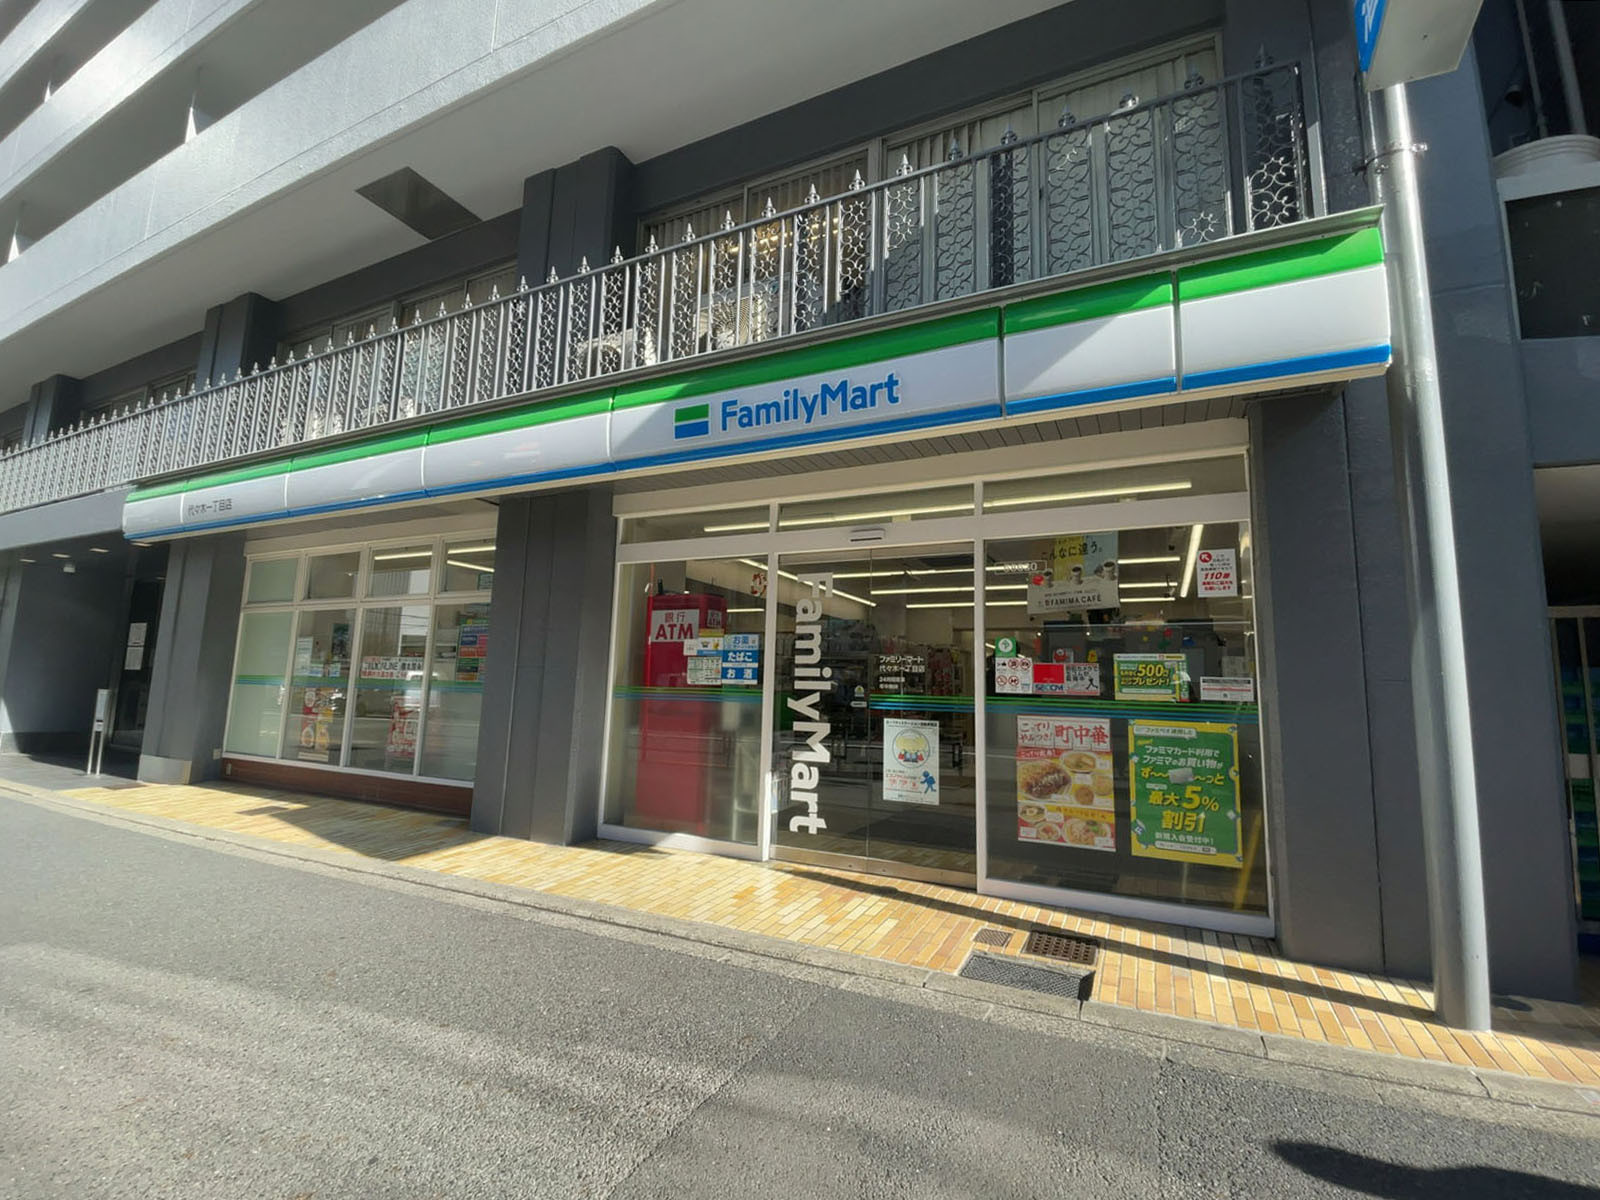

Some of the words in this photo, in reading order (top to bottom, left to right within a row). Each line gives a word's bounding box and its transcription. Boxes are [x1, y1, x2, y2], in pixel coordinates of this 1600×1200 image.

[721, 373, 899, 431] FamilyMart
[188, 498, 232, 516] 代々木一丁目店
[655, 623, 694, 640] ATM
[727, 651, 753, 662] たばこ
[879, 655, 924, 663] ファミリーマート
[787, 572, 834, 835] FamilyMart
[1055, 724, 1109, 745] 町中華
[1144, 745, 1220, 758] ファミマカード利用で
[1143, 755, 1224, 769] ファミマのお買い物が
[1148, 785, 1220, 812] 最大5%
